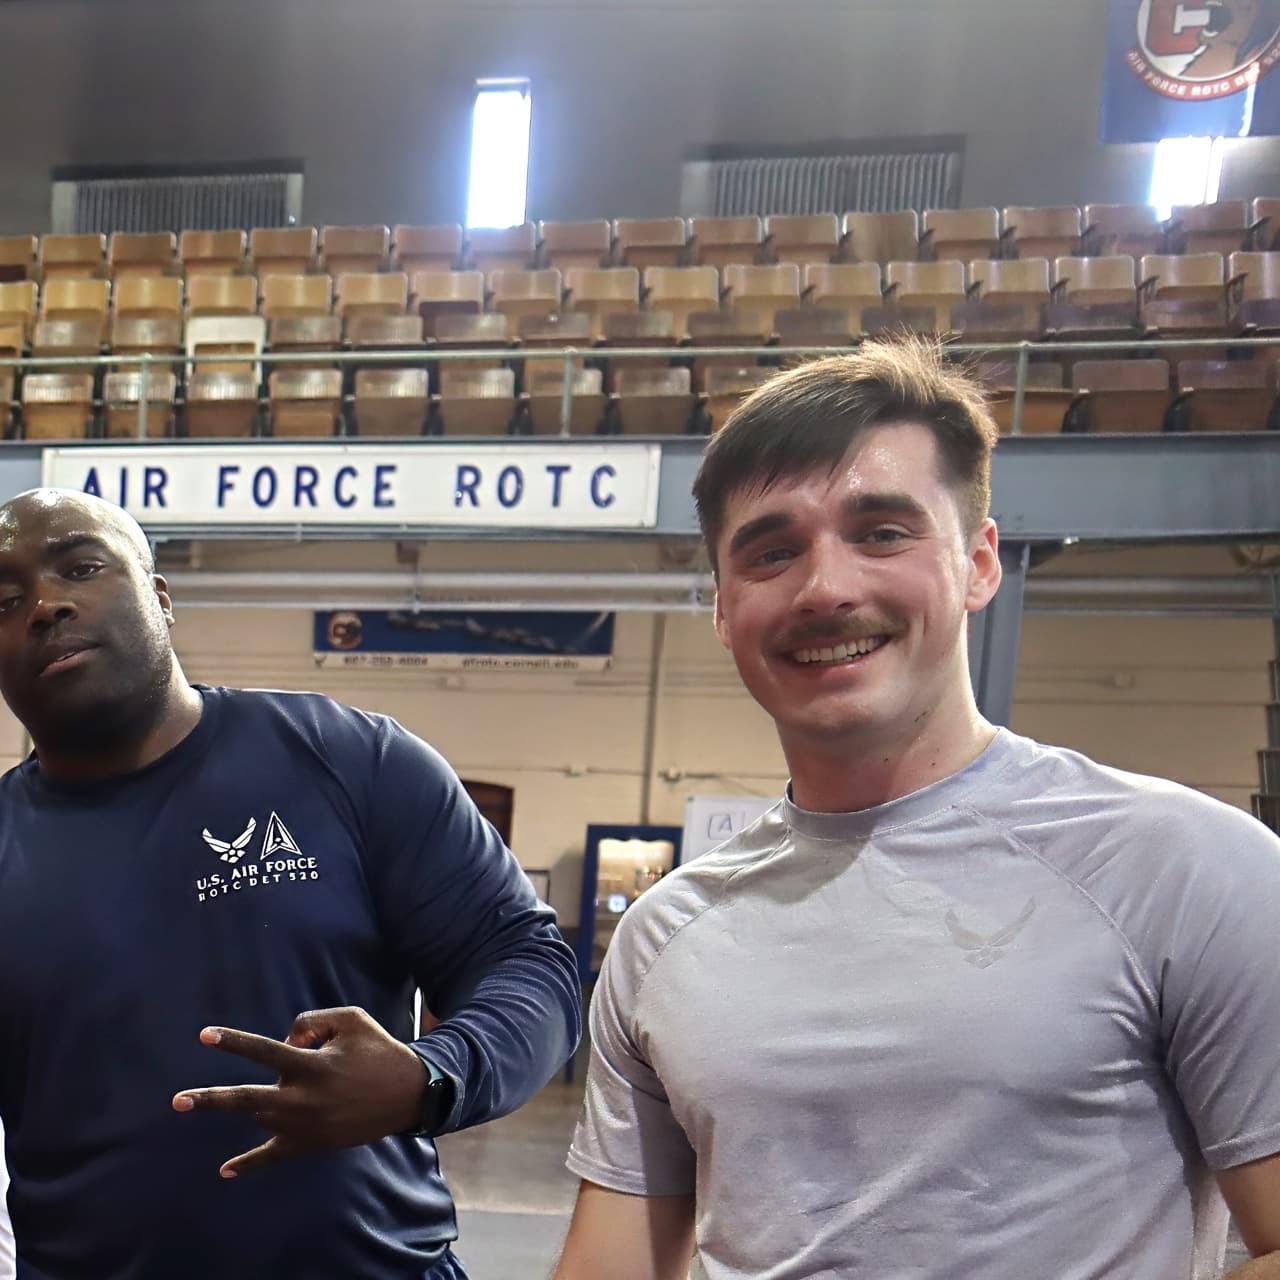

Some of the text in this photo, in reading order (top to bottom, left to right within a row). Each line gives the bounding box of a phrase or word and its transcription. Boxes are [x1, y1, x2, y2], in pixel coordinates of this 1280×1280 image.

[81, 463, 619, 508] AIR FORCE ROTC
[196, 857, 318, 890] U.S. AIR FORCE
[198, 881, 241, 902] ROTC
[249, 874, 281, 887] DET
